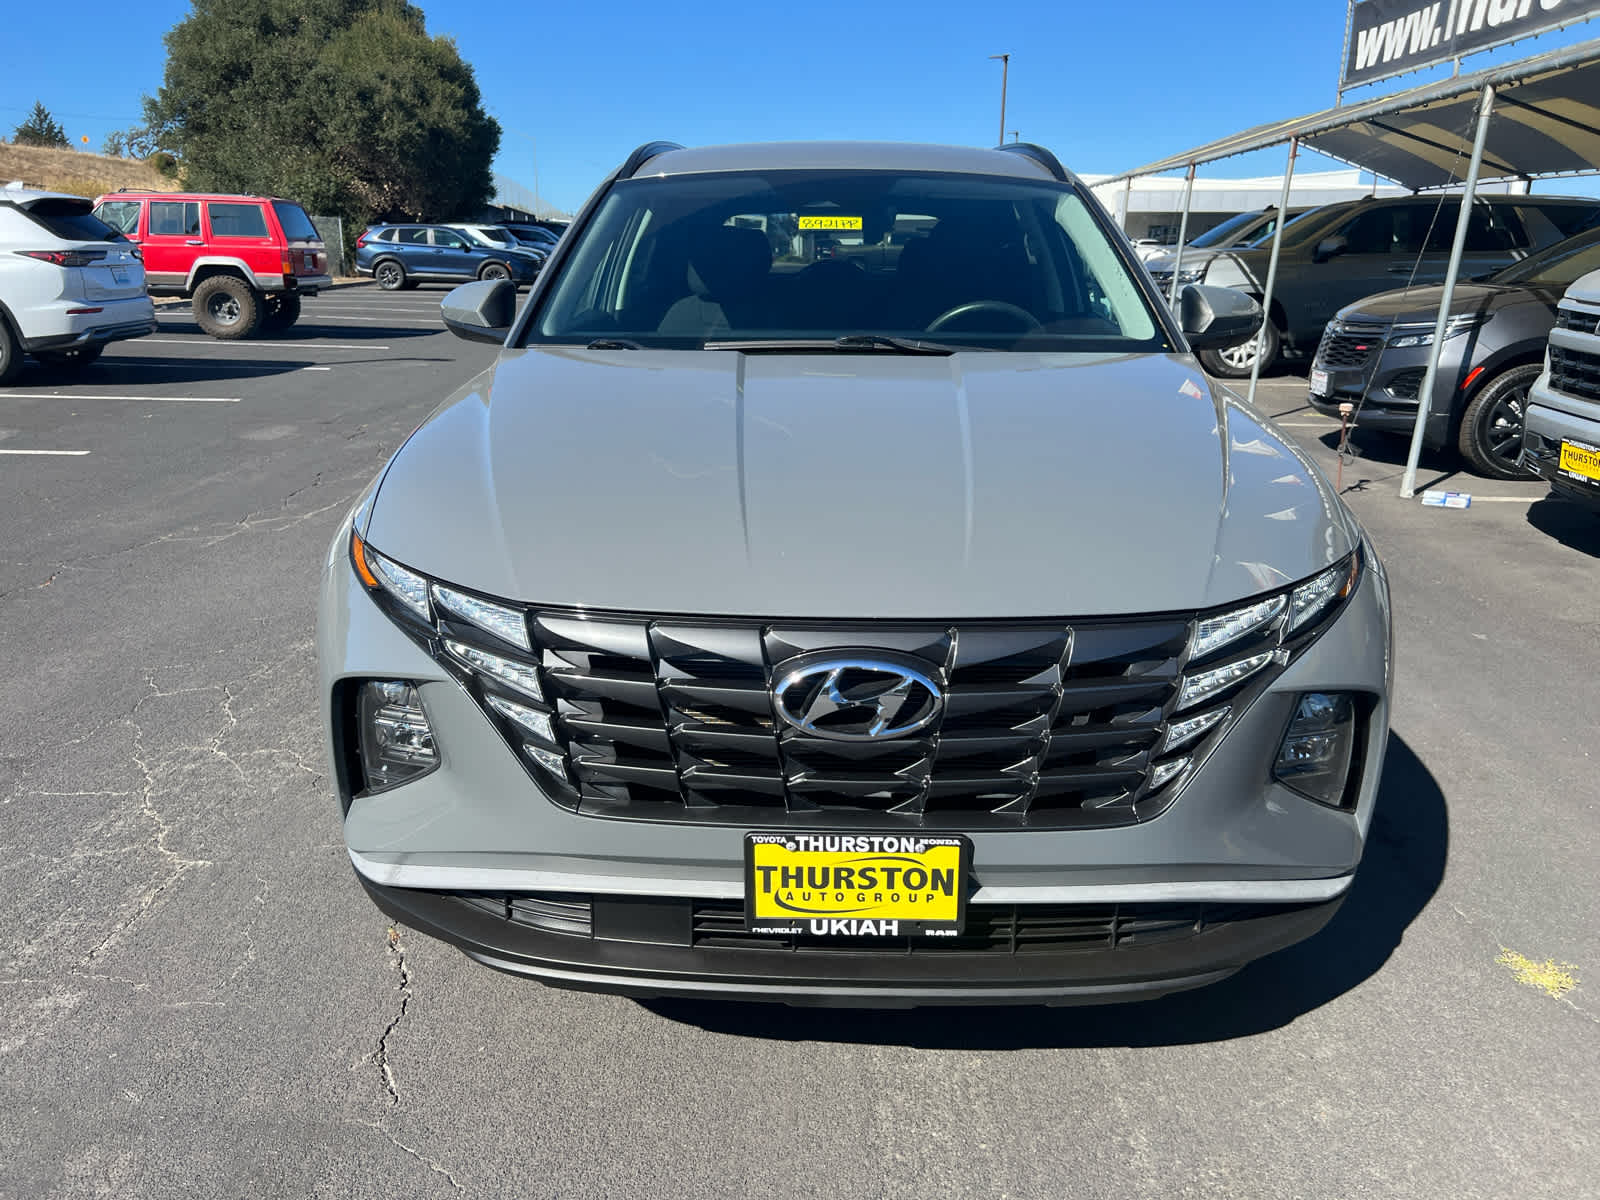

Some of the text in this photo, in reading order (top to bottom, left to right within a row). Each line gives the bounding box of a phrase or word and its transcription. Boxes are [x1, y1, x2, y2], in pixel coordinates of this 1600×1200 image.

[751, 836, 787, 844] TOYOTA
[795, 836, 915, 853] THURSTON
[919, 838, 961, 846] HONDA
[756, 865, 954, 896] THURSTON
[785, 892, 935, 903] AUTO GROUP
[751, 927, 803, 935] CHEVROLET
[809, 919, 898, 936] UKIAH
